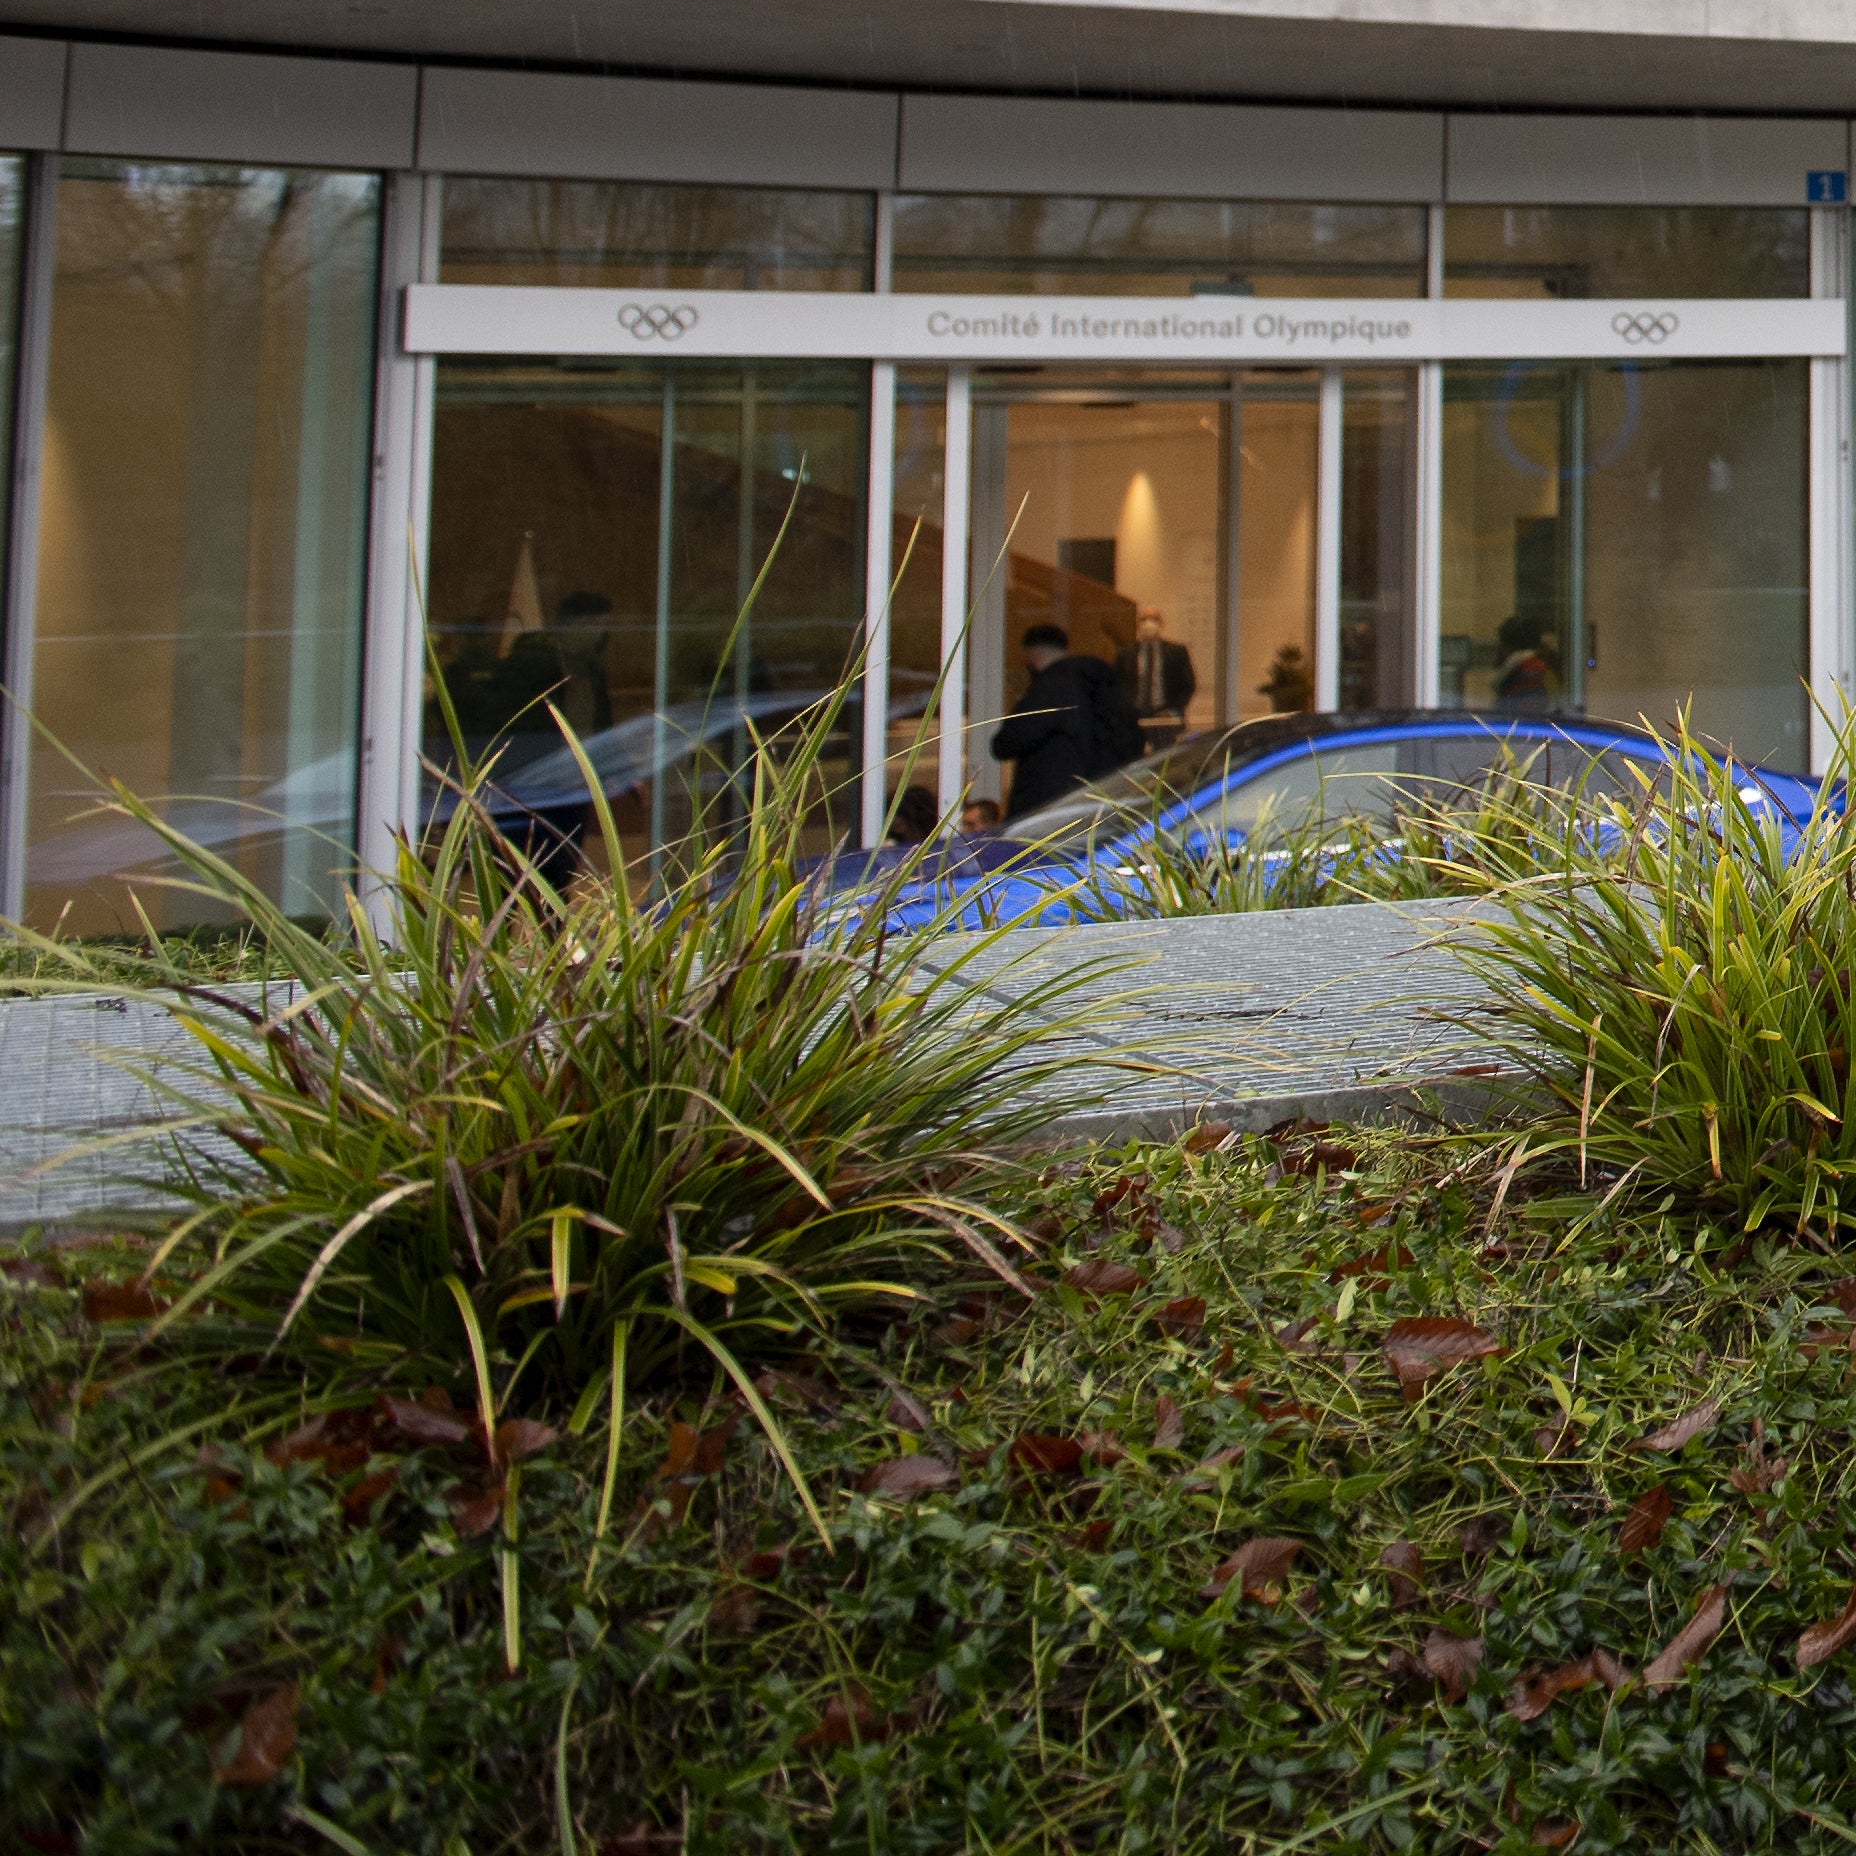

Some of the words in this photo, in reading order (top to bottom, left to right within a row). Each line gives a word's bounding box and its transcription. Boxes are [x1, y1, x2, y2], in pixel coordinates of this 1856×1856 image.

[1818, 173, 1835, 201] 1
[927, 310, 1040, 338] Comité
[1050, 313, 1243, 340] International
[1253, 312, 1412, 344] Olympique
